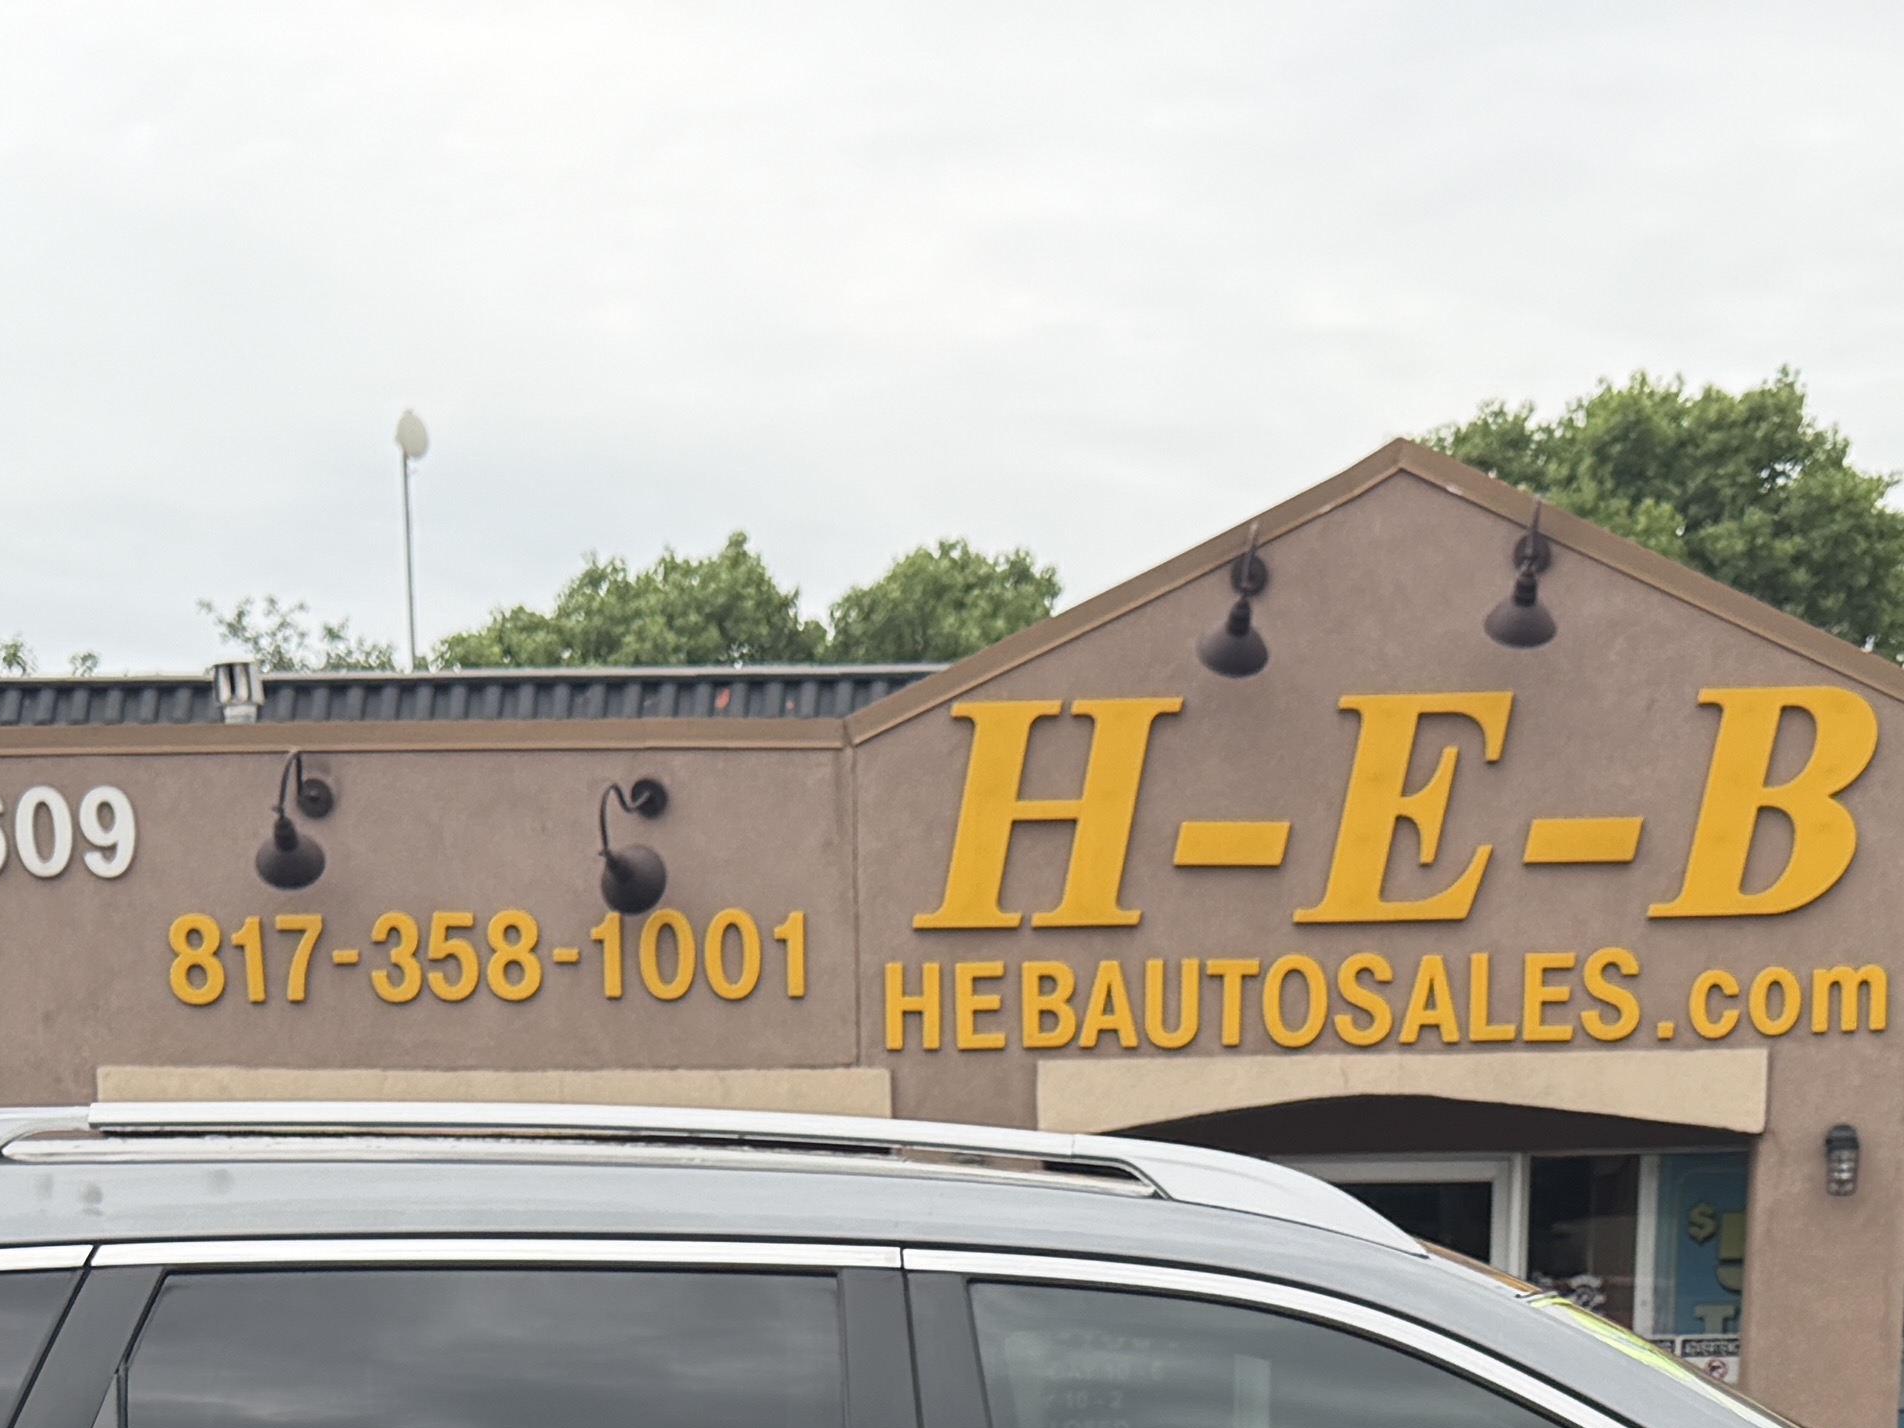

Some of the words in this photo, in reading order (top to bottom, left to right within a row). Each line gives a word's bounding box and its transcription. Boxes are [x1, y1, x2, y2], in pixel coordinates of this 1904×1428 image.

[912, 685, 1881, 929] H-E-B
[169, 907, 808, 1006] 817-358-1001
[884, 947, 1889, 1051] HEBAUTOSALES.com
